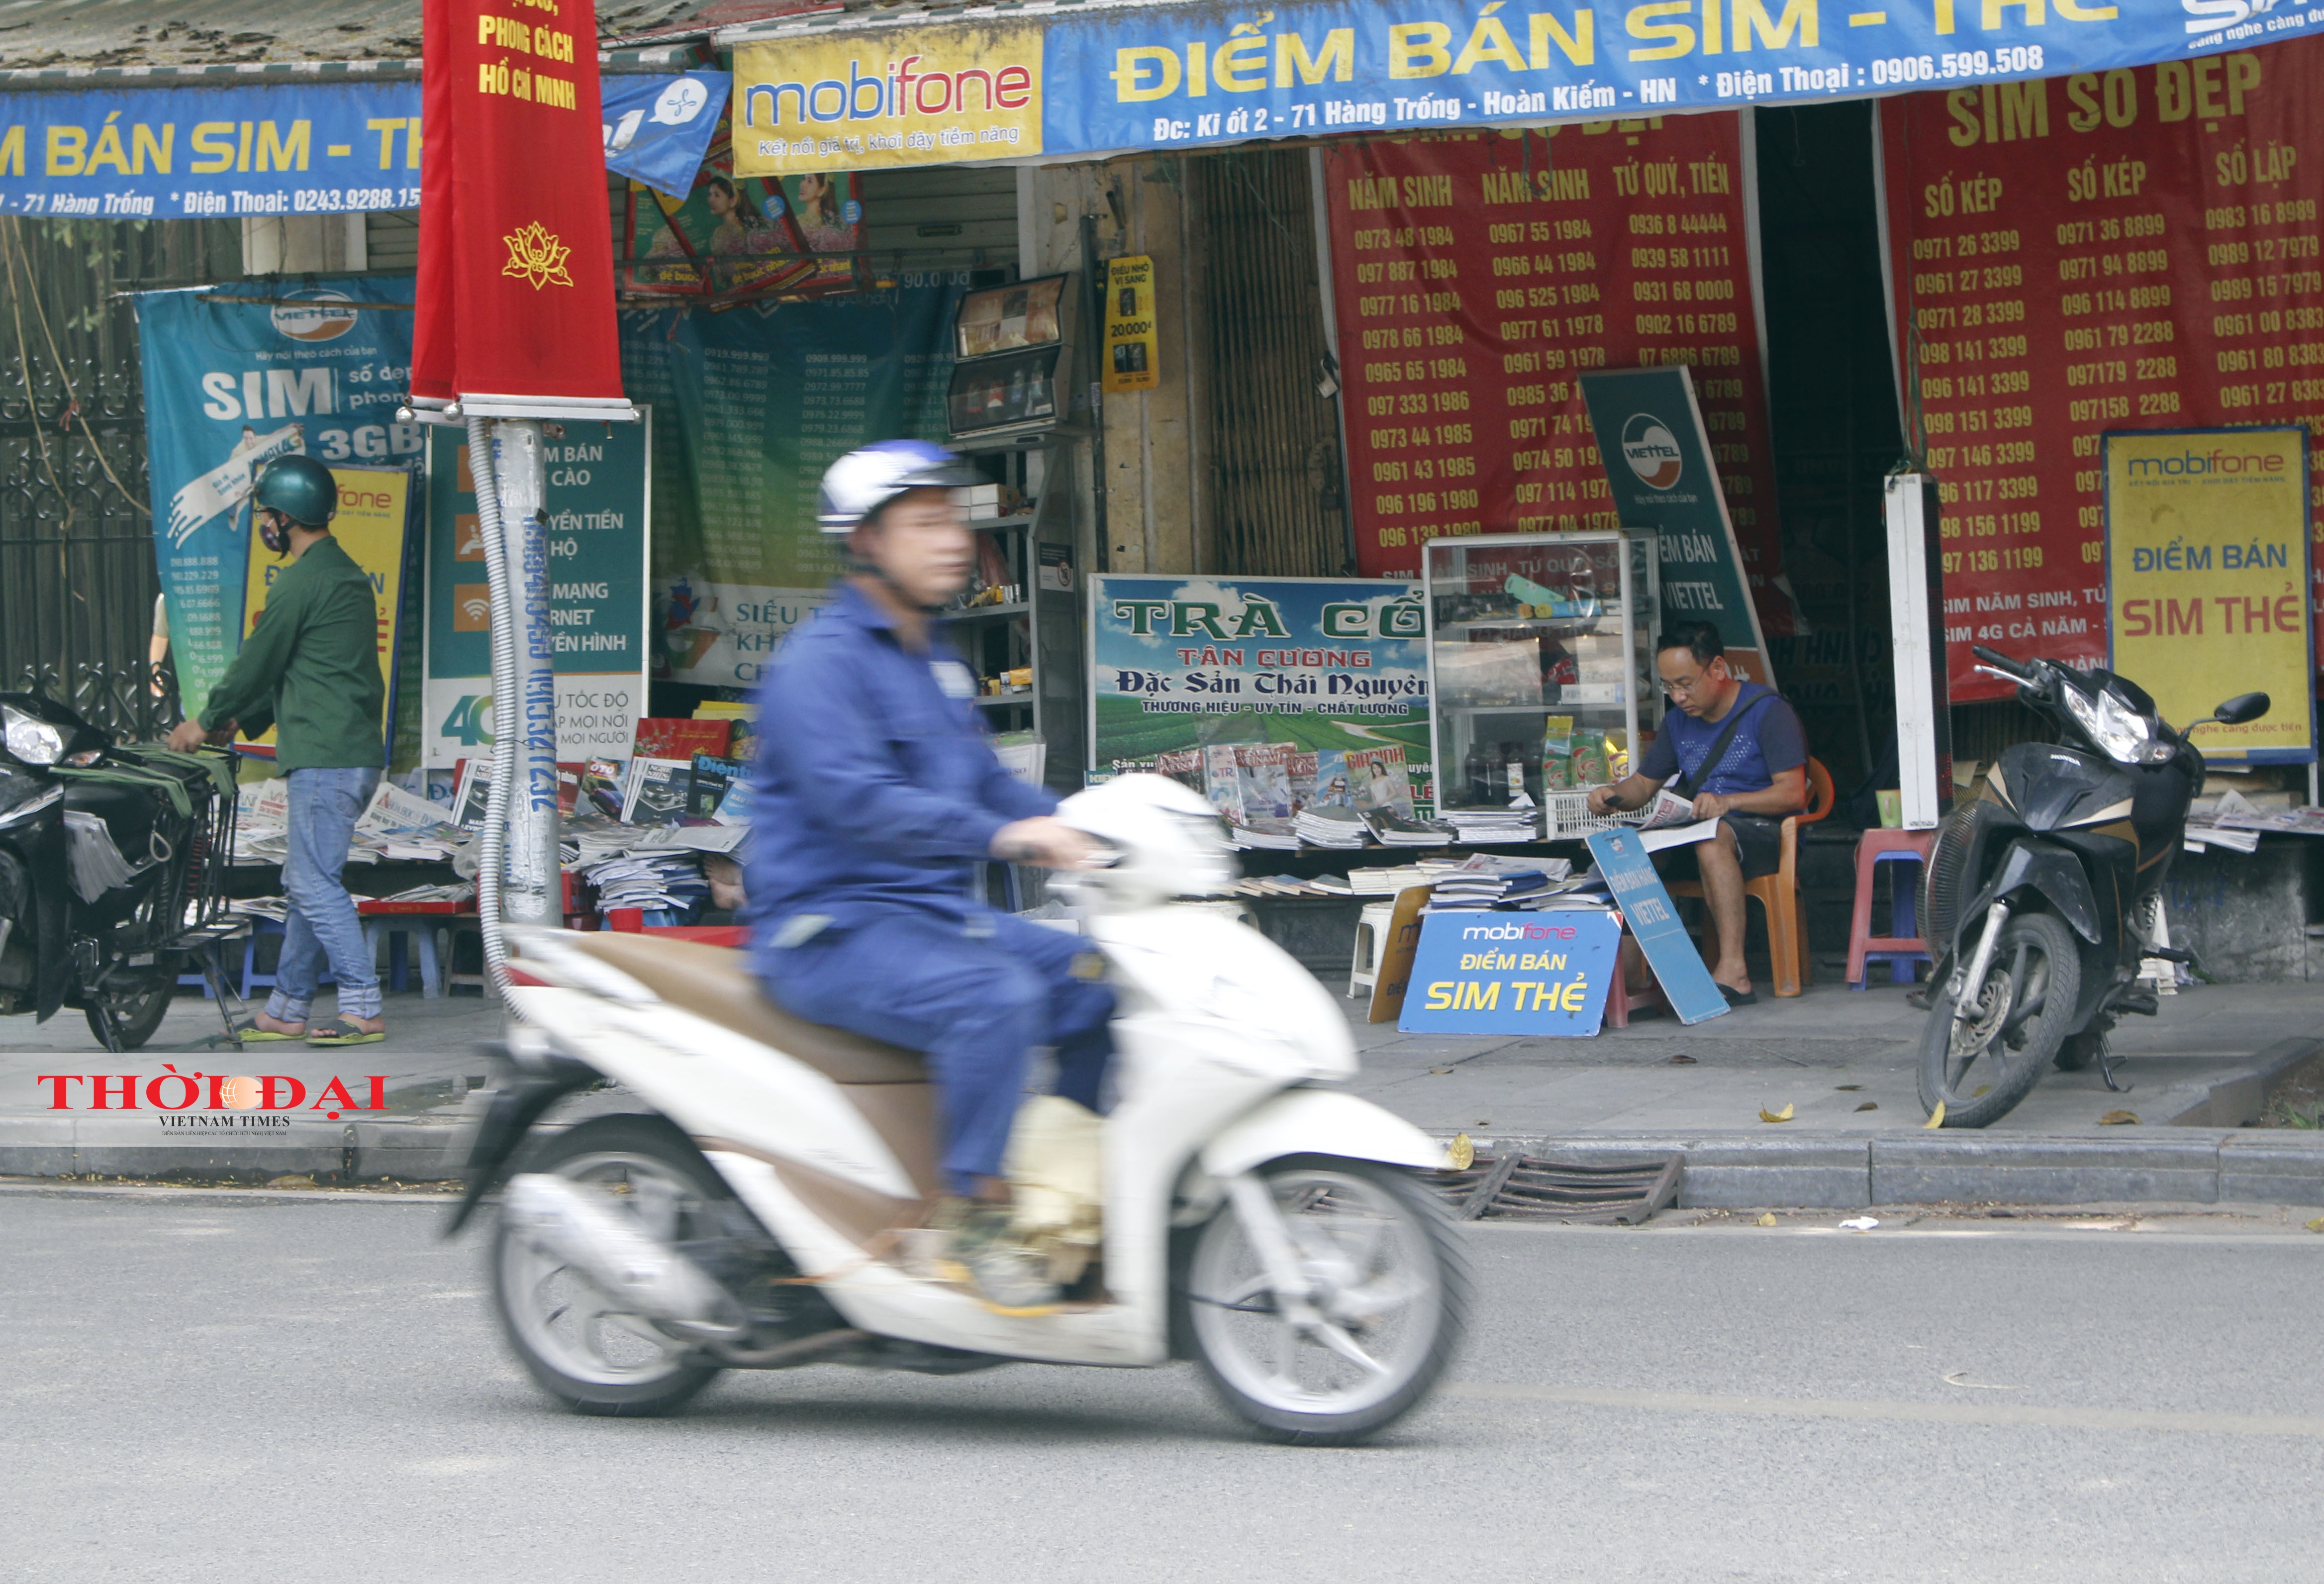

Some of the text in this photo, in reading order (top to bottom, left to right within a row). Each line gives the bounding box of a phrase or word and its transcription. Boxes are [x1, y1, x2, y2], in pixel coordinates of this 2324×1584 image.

[479, 14, 574, 64] PHONG CÁCH
[2226, 15, 2305, 40] nghe càng
[1109, 0, 1819, 103] ĐIỂM BÁN SIM
[479, 56, 576, 110] HỒ CHÍ MINH
[746, 55, 1031, 127] mobifone
[1154, 45, 2044, 142] Đc: Ki ốt 2 71 Hàng Trống Hoàn Kiếm HN Điện Thoại 0906.599.508
[2154, 53, 2262, 133] ĐẸP
[46, 110, 311, 176] BÁN SIM
[759, 140, 787, 156] Kết
[790, 137, 815, 155] nối
[819, 137, 841, 157] giá
[906, 131, 935, 150] dậy
[980, 126, 1019, 144] năng
[1644, 156, 1685, 198] QUÝ,
[2068, 153, 2146, 202] SỐ KÉP
[2216, 137, 2296, 189] SỐ LẶP
[1349, 172, 1452, 209] NĂM SINH
[1482, 166, 1590, 204] NĂM SINH
[1925, 170, 2003, 218] SỐ KÉP
[24, 193, 45, 212] 71
[50, 193, 99, 214] Hàng
[104, 189, 154, 215] Trống
[184, 192, 227, 216] Điện
[294, 188, 421, 211] 0243.9288.15
[2206, 199, 2316, 230] 0983 16 8989
[1355, 226, 1453, 250] 0973 48 1984
[1489, 219, 1592, 243] 0967 55 1984
[1629, 213, 1727, 234] 0936 8 44444
[2057, 213, 2165, 245] 0971 36 8899
[1913, 229, 2020, 260] 0971 26 3399
[349, 362, 373, 383] số
[1365, 358, 1467, 383] 0965 65 1984
[202, 367, 332, 421] SIM
[1925, 405, 2033, 434] 098 151 3399
[318, 422, 423, 460] 3GB
[564, 442, 602, 462] BÁN
[1626, 444, 1679, 459] VIETTEL
[551, 467, 591, 486] CÀO
[2129, 449, 2284, 476] mobifone
[584, 508, 623, 529] TIỀN
[551, 537, 578, 561] HỘ
[1682, 528, 1717, 563] BÁN
[2132, 536, 2287, 573] ĐIỂM BÁN
[553, 583, 608, 603] MẠNG
[1976, 590, 2078, 611] NĂM SINH,
[1114, 592, 1292, 641] TRÀ
[2122, 582, 2300, 637] SIM THẺ
[582, 631, 626, 651] HÌNH
[1978, 616, 2087, 640] 4G CẢ NĂM
[1177, 644, 1371, 668] TÂN CƯƠNG
[1115, 670, 1429, 700] Đặc Sản Thái Nguyên
[566, 690, 628, 711] TỐC ĐỘ
[1142, 699, 1409, 717] THƯƠNG HIỆU UY TÍN CHẤT LƯỢNG
[571, 715, 597, 730] MỌI
[561, 733, 584, 744] MỌI
[1630, 897, 1670, 925] VIETTEL
[1463, 922, 1575, 940] mobifone
[1460, 947, 1566, 970] ĐIỂM BÁN
[1425, 973, 1588, 1011] SIM THẺ
